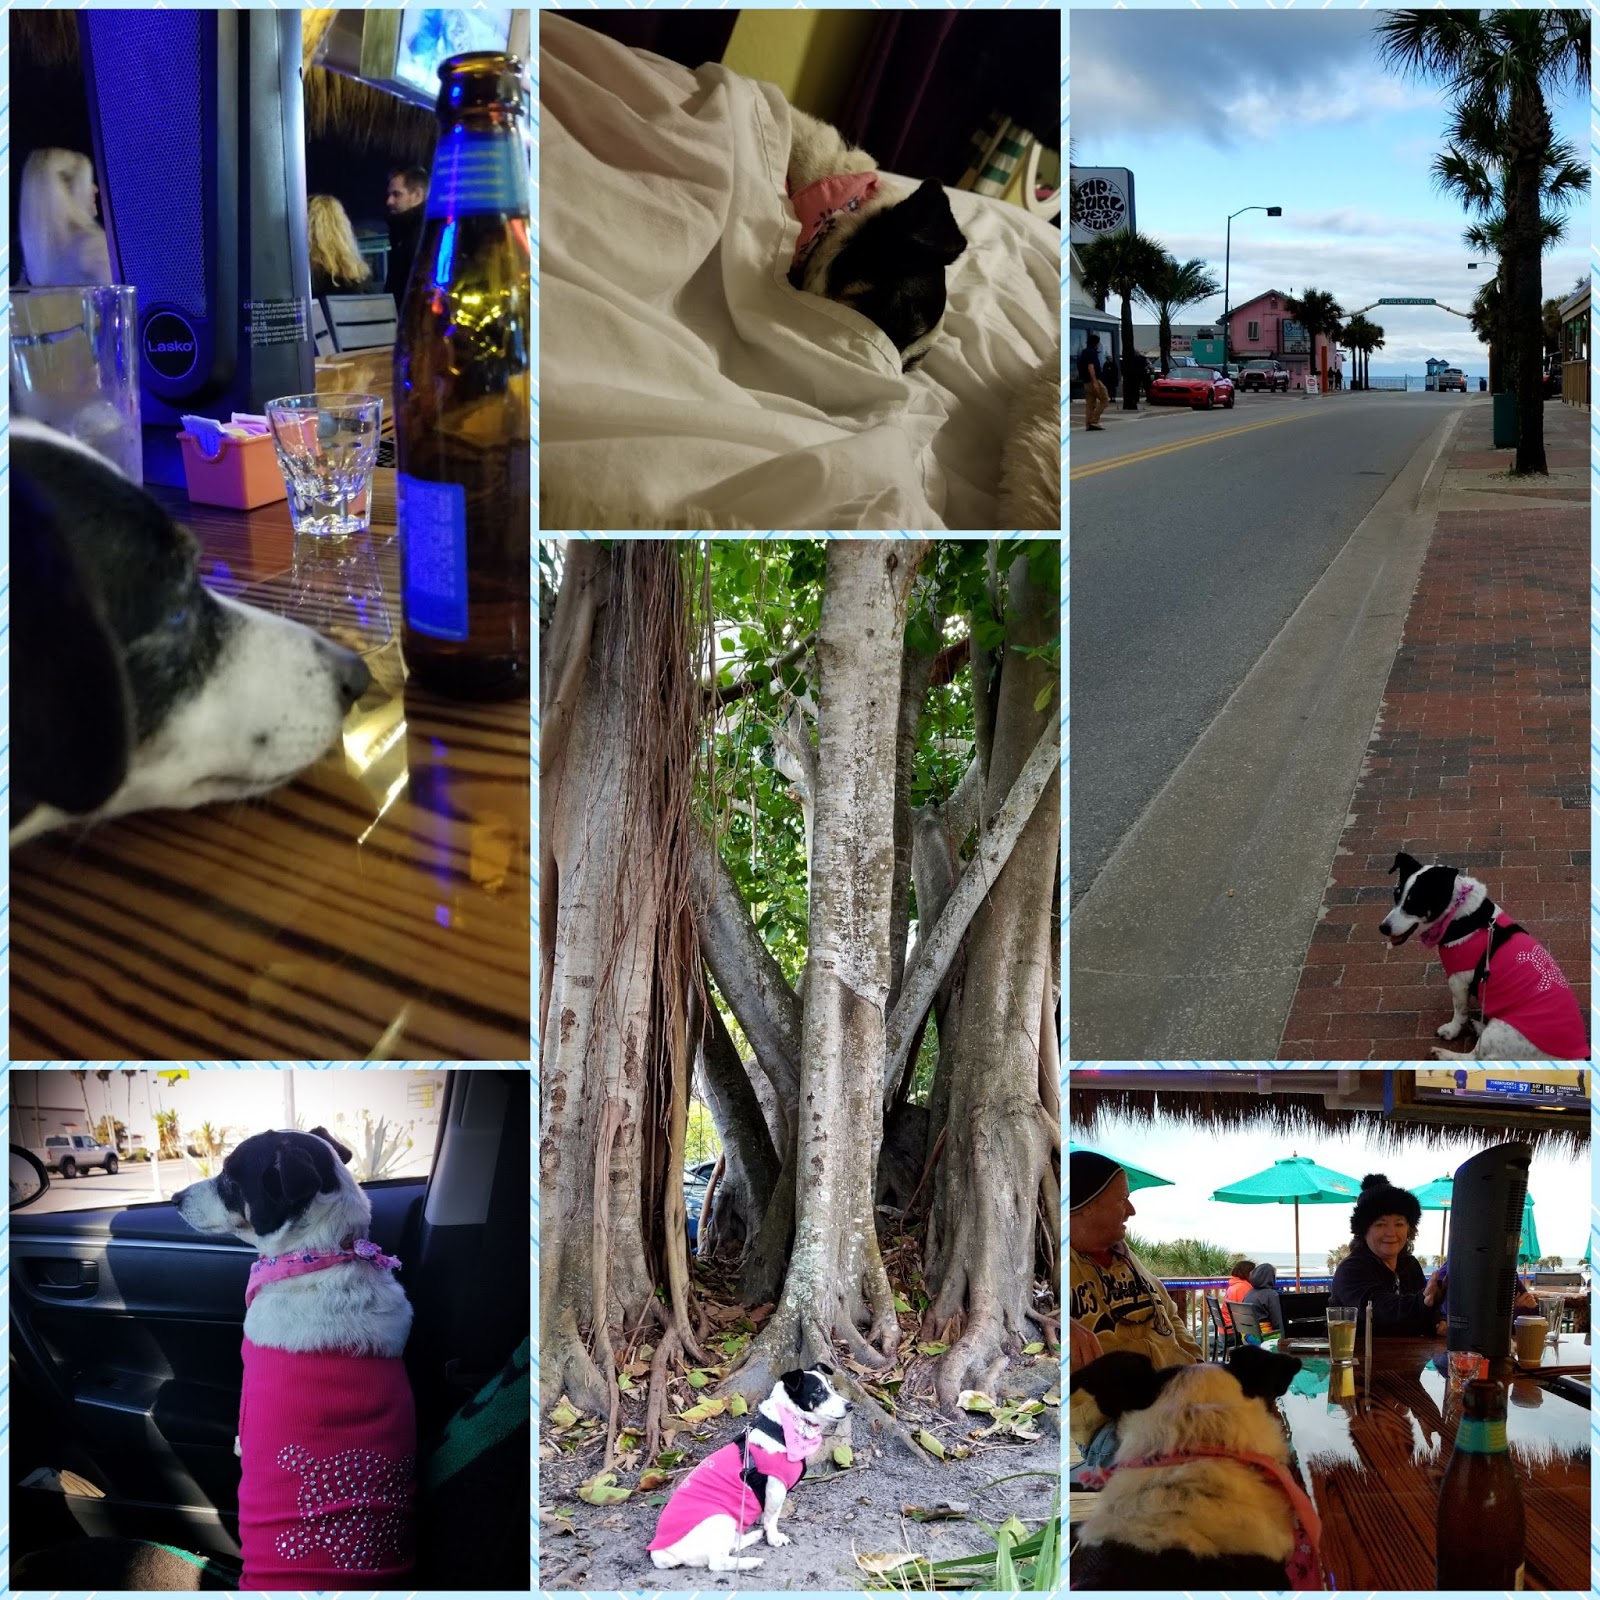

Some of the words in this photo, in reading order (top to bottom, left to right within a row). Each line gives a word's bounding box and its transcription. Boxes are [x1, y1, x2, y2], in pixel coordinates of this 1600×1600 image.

[1078, 179, 1108, 197] RIP
[1076, 196, 1125, 212] CURL
[1083, 211, 1122, 230] SUITS
[148, 340, 192, 353] Lasko
[1519, 1084, 1528, 1092] 57
[1545, 1085, 1555, 1094] 56
